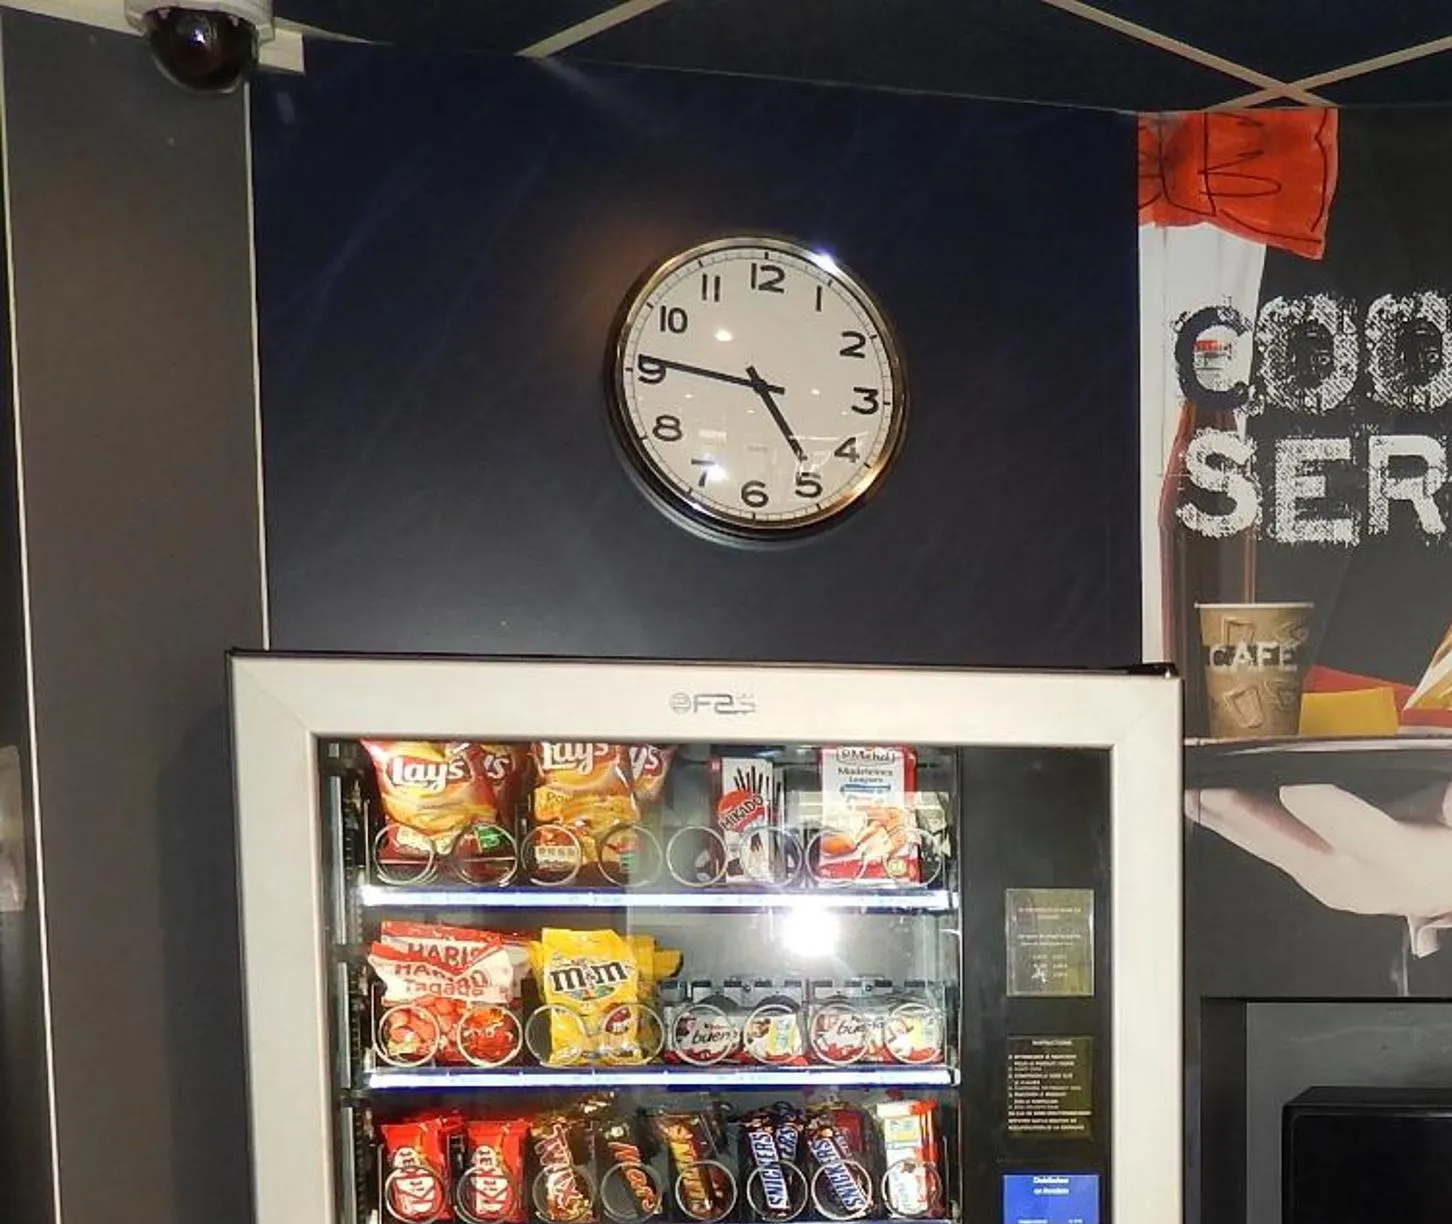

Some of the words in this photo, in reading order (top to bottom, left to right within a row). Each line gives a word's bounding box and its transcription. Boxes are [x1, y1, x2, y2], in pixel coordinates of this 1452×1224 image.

[702, 274, 720, 302] 11
[751, 263, 786, 293] 12
[815, 285, 823, 312] 1
[660, 305, 688, 334] 10
[839, 331, 866, 358] 2
[638, 354, 666, 384] 9
[851, 387, 879, 415] 3
[652, 415, 683, 442] 8
[834, 437, 860, 464] 4
[741, 480, 769, 508] 6
[795, 472, 823, 498] 5
[541, 743, 610, 775] Lays
[716, 791, 765, 832] MIKADO
[395, 964, 488, 988] HABO
